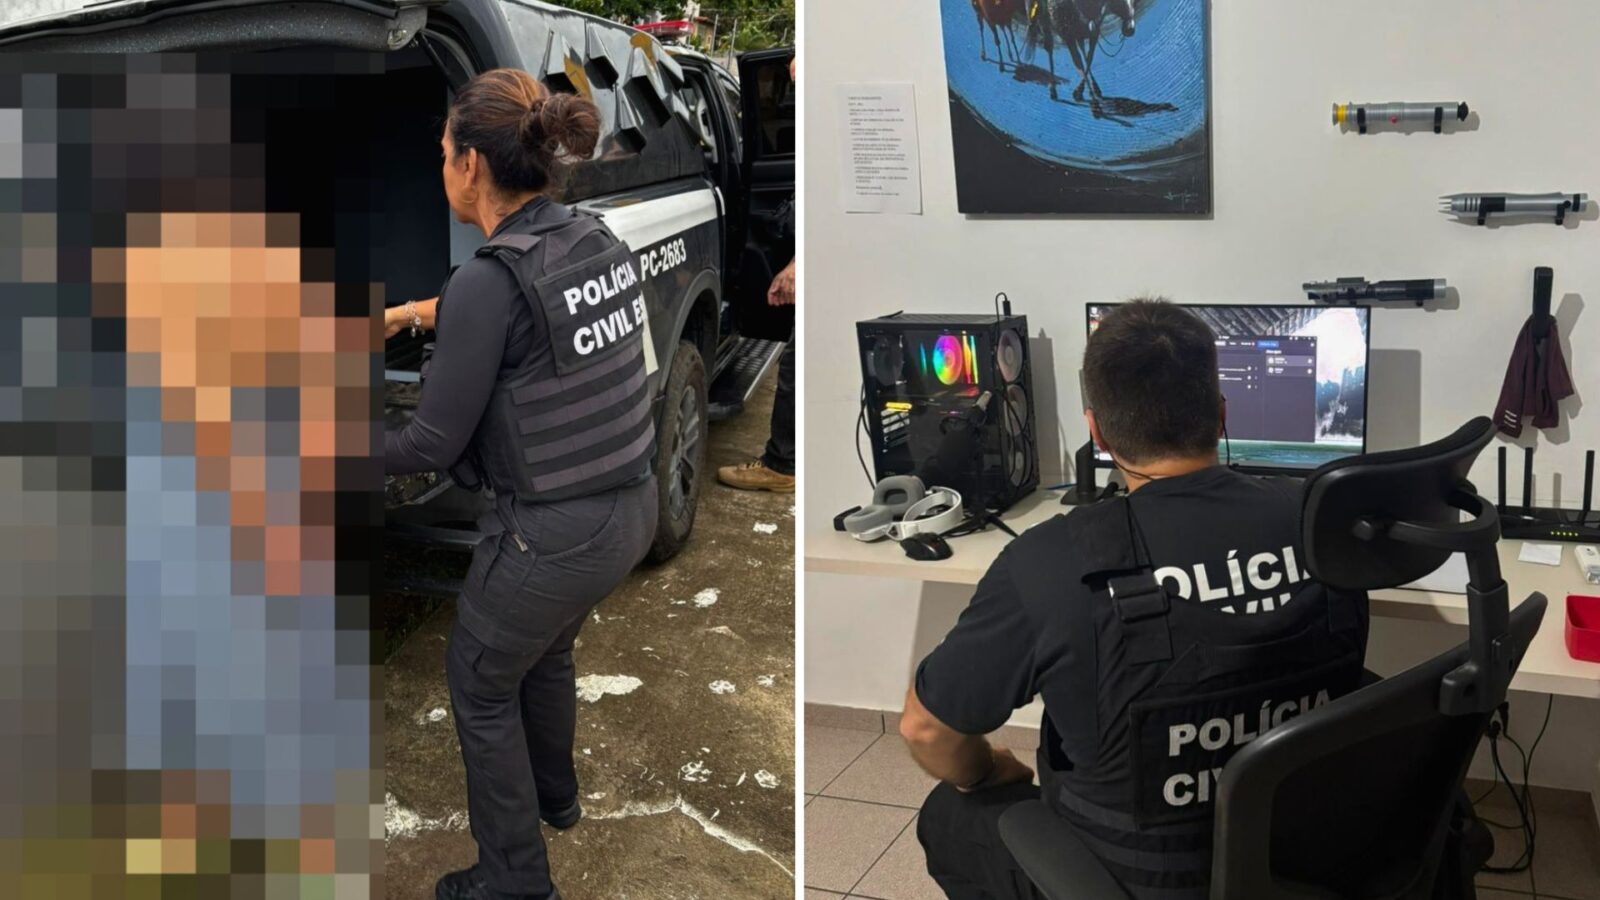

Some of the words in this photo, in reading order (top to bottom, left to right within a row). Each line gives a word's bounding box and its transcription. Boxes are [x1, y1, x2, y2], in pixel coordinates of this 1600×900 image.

[640, 238, 687, 281] PC-2683
[563, 261, 638, 315] POLÍCIA
[573, 307, 633, 355] CIVIL
[1109, 545, 1311, 602] OLÍCI
